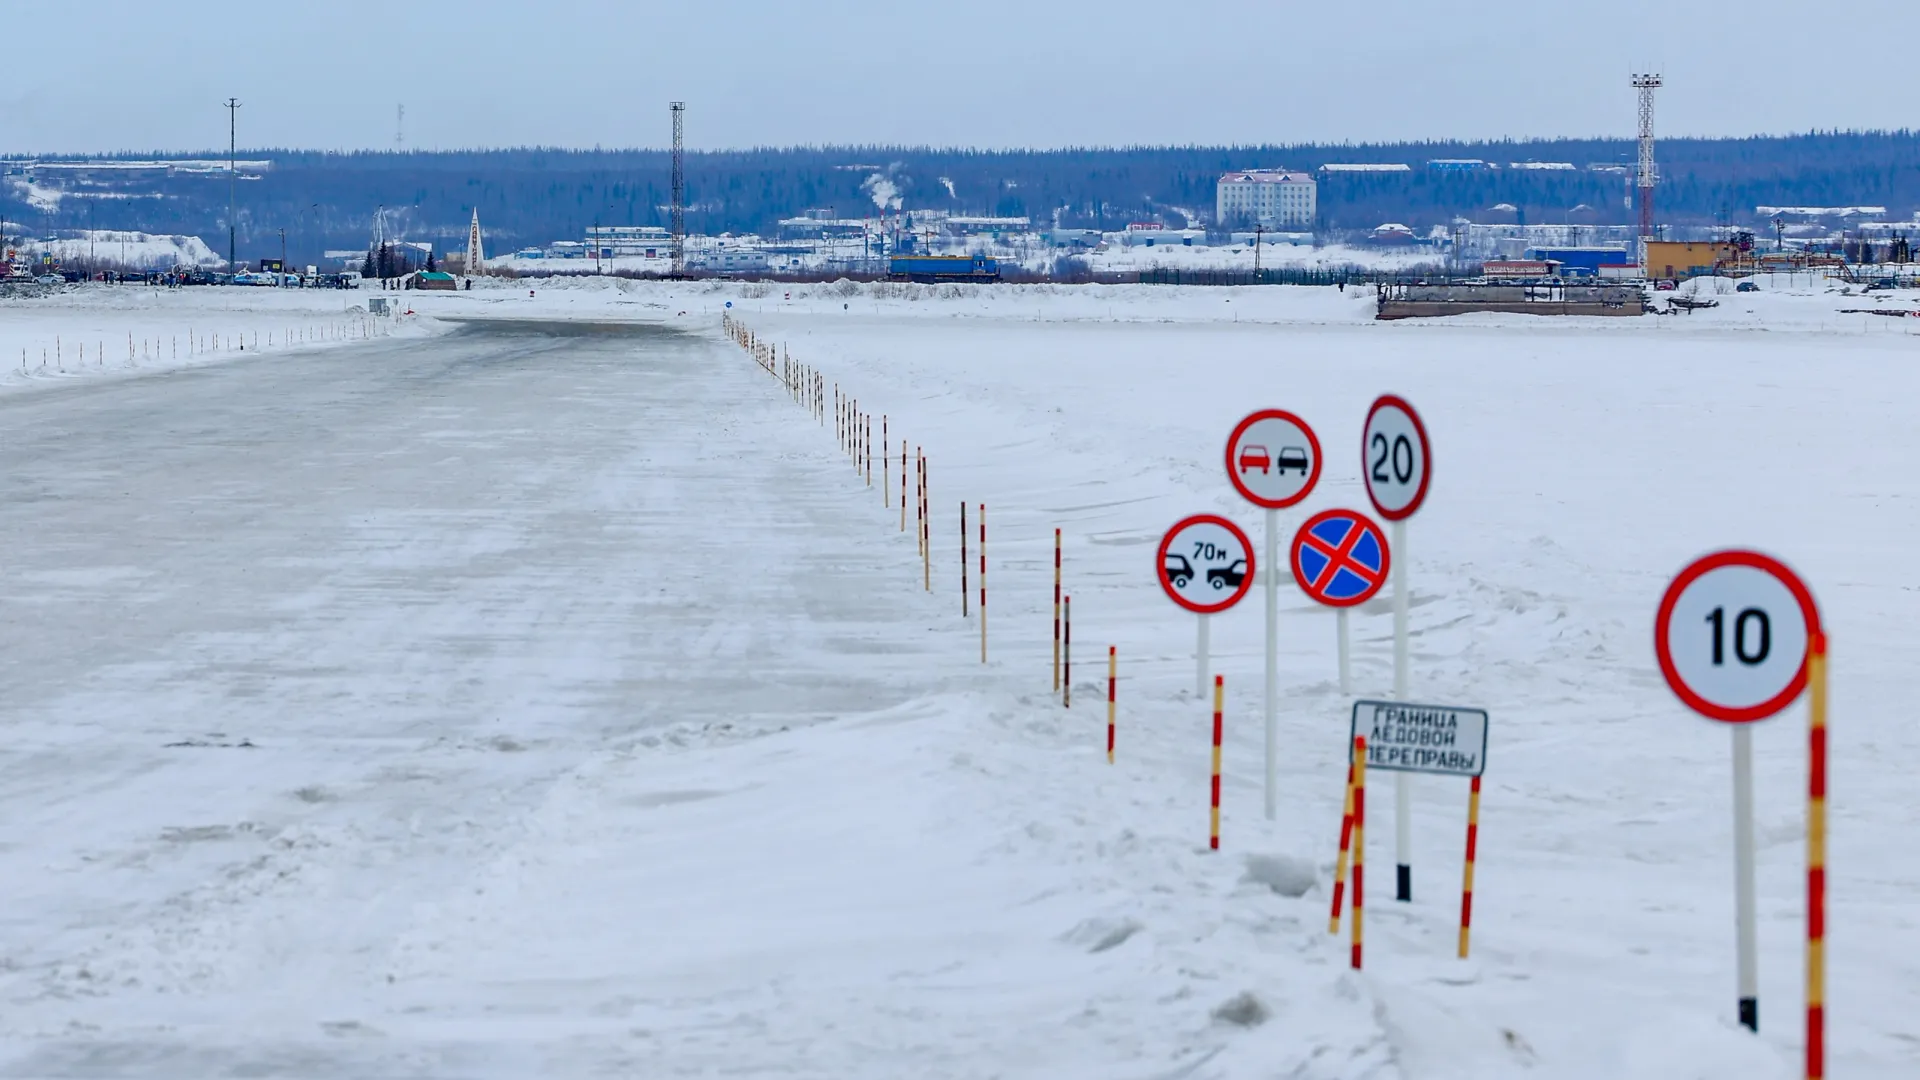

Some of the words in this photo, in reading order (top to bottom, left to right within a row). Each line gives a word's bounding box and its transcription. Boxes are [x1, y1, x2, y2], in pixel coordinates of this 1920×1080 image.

[1371, 432, 1413, 485] 20
[1705, 605, 1771, 667] 10
[1374, 706, 1457, 728] ГРАНИЦА
